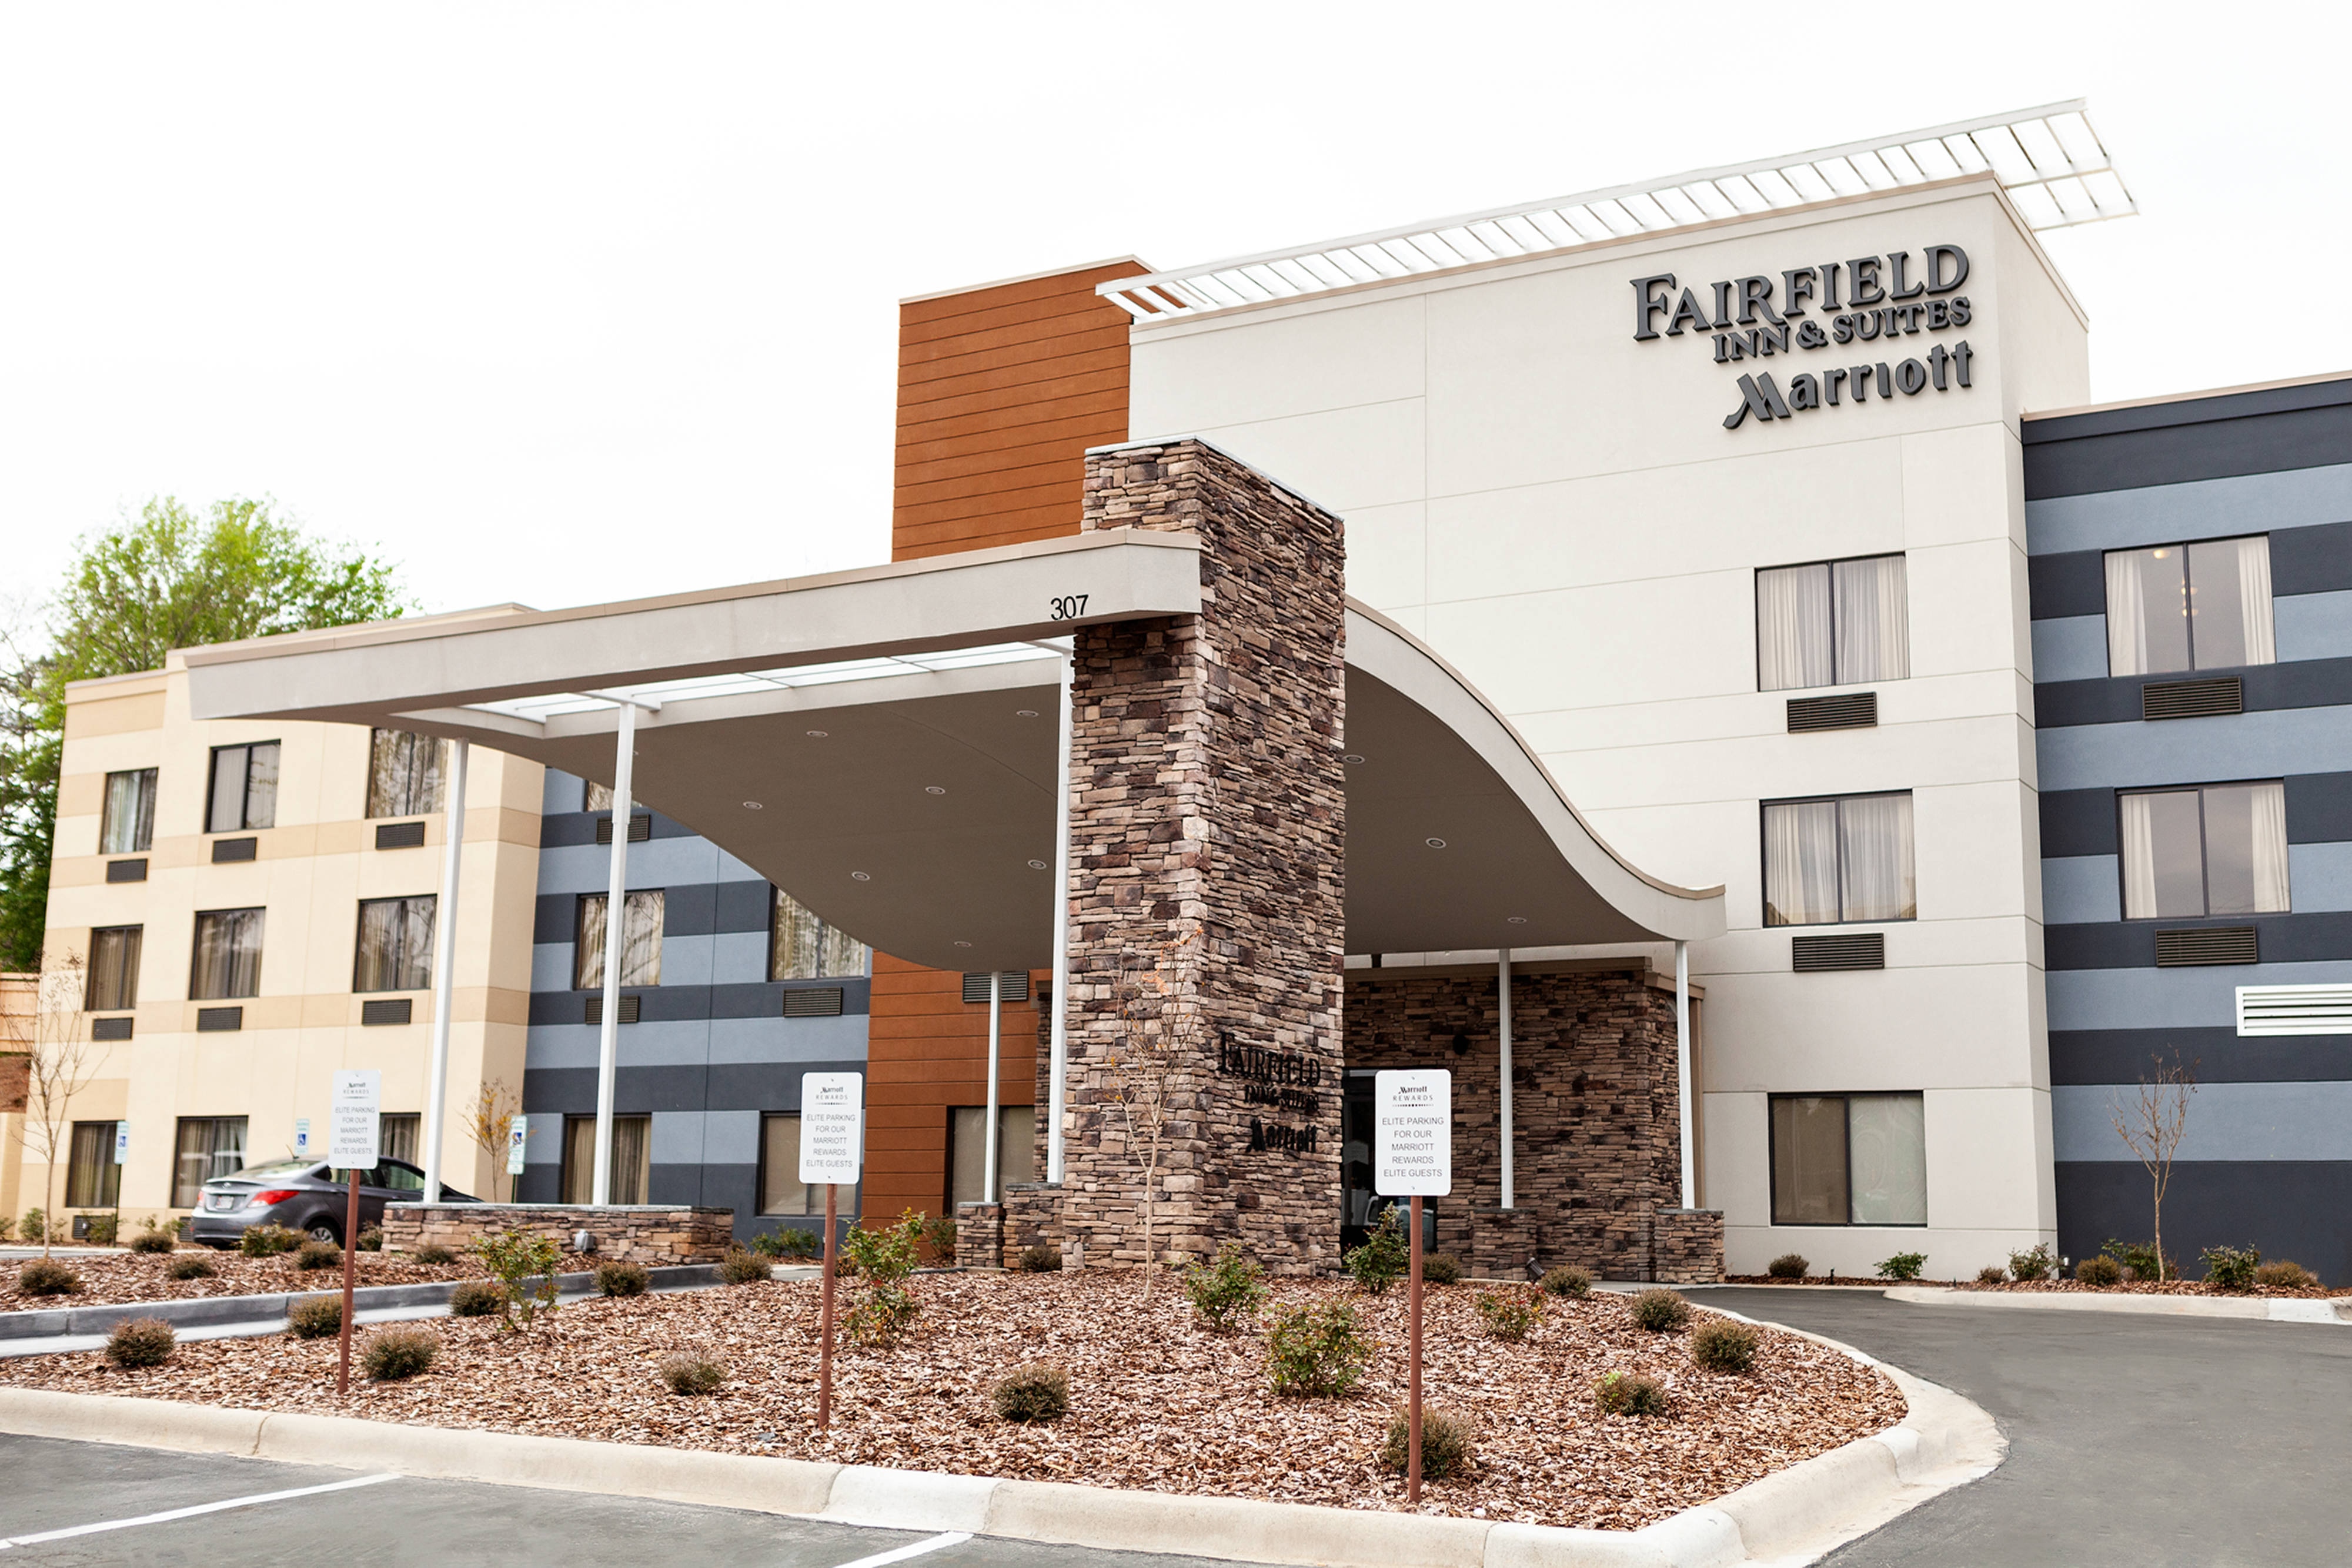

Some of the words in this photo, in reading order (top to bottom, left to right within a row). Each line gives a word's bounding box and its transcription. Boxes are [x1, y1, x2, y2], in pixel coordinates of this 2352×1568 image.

[1630, 244, 1970, 342] FAIRFIELD
[1712, 324, 1790, 363] INN
[1795, 320, 1829, 349] &
[1832, 296, 1972, 345] SUITES
[1722, 340, 1973, 430] Marriott
[1051, 594, 1088, 620] 307
[1220, 1031, 1321, 1087] FAIRFIELD
[1245, 1119, 1316, 1152] Marriott
[1382, 1117, 1405, 1125] ELITE
[1407, 1117, 1444, 1125] PARKING
